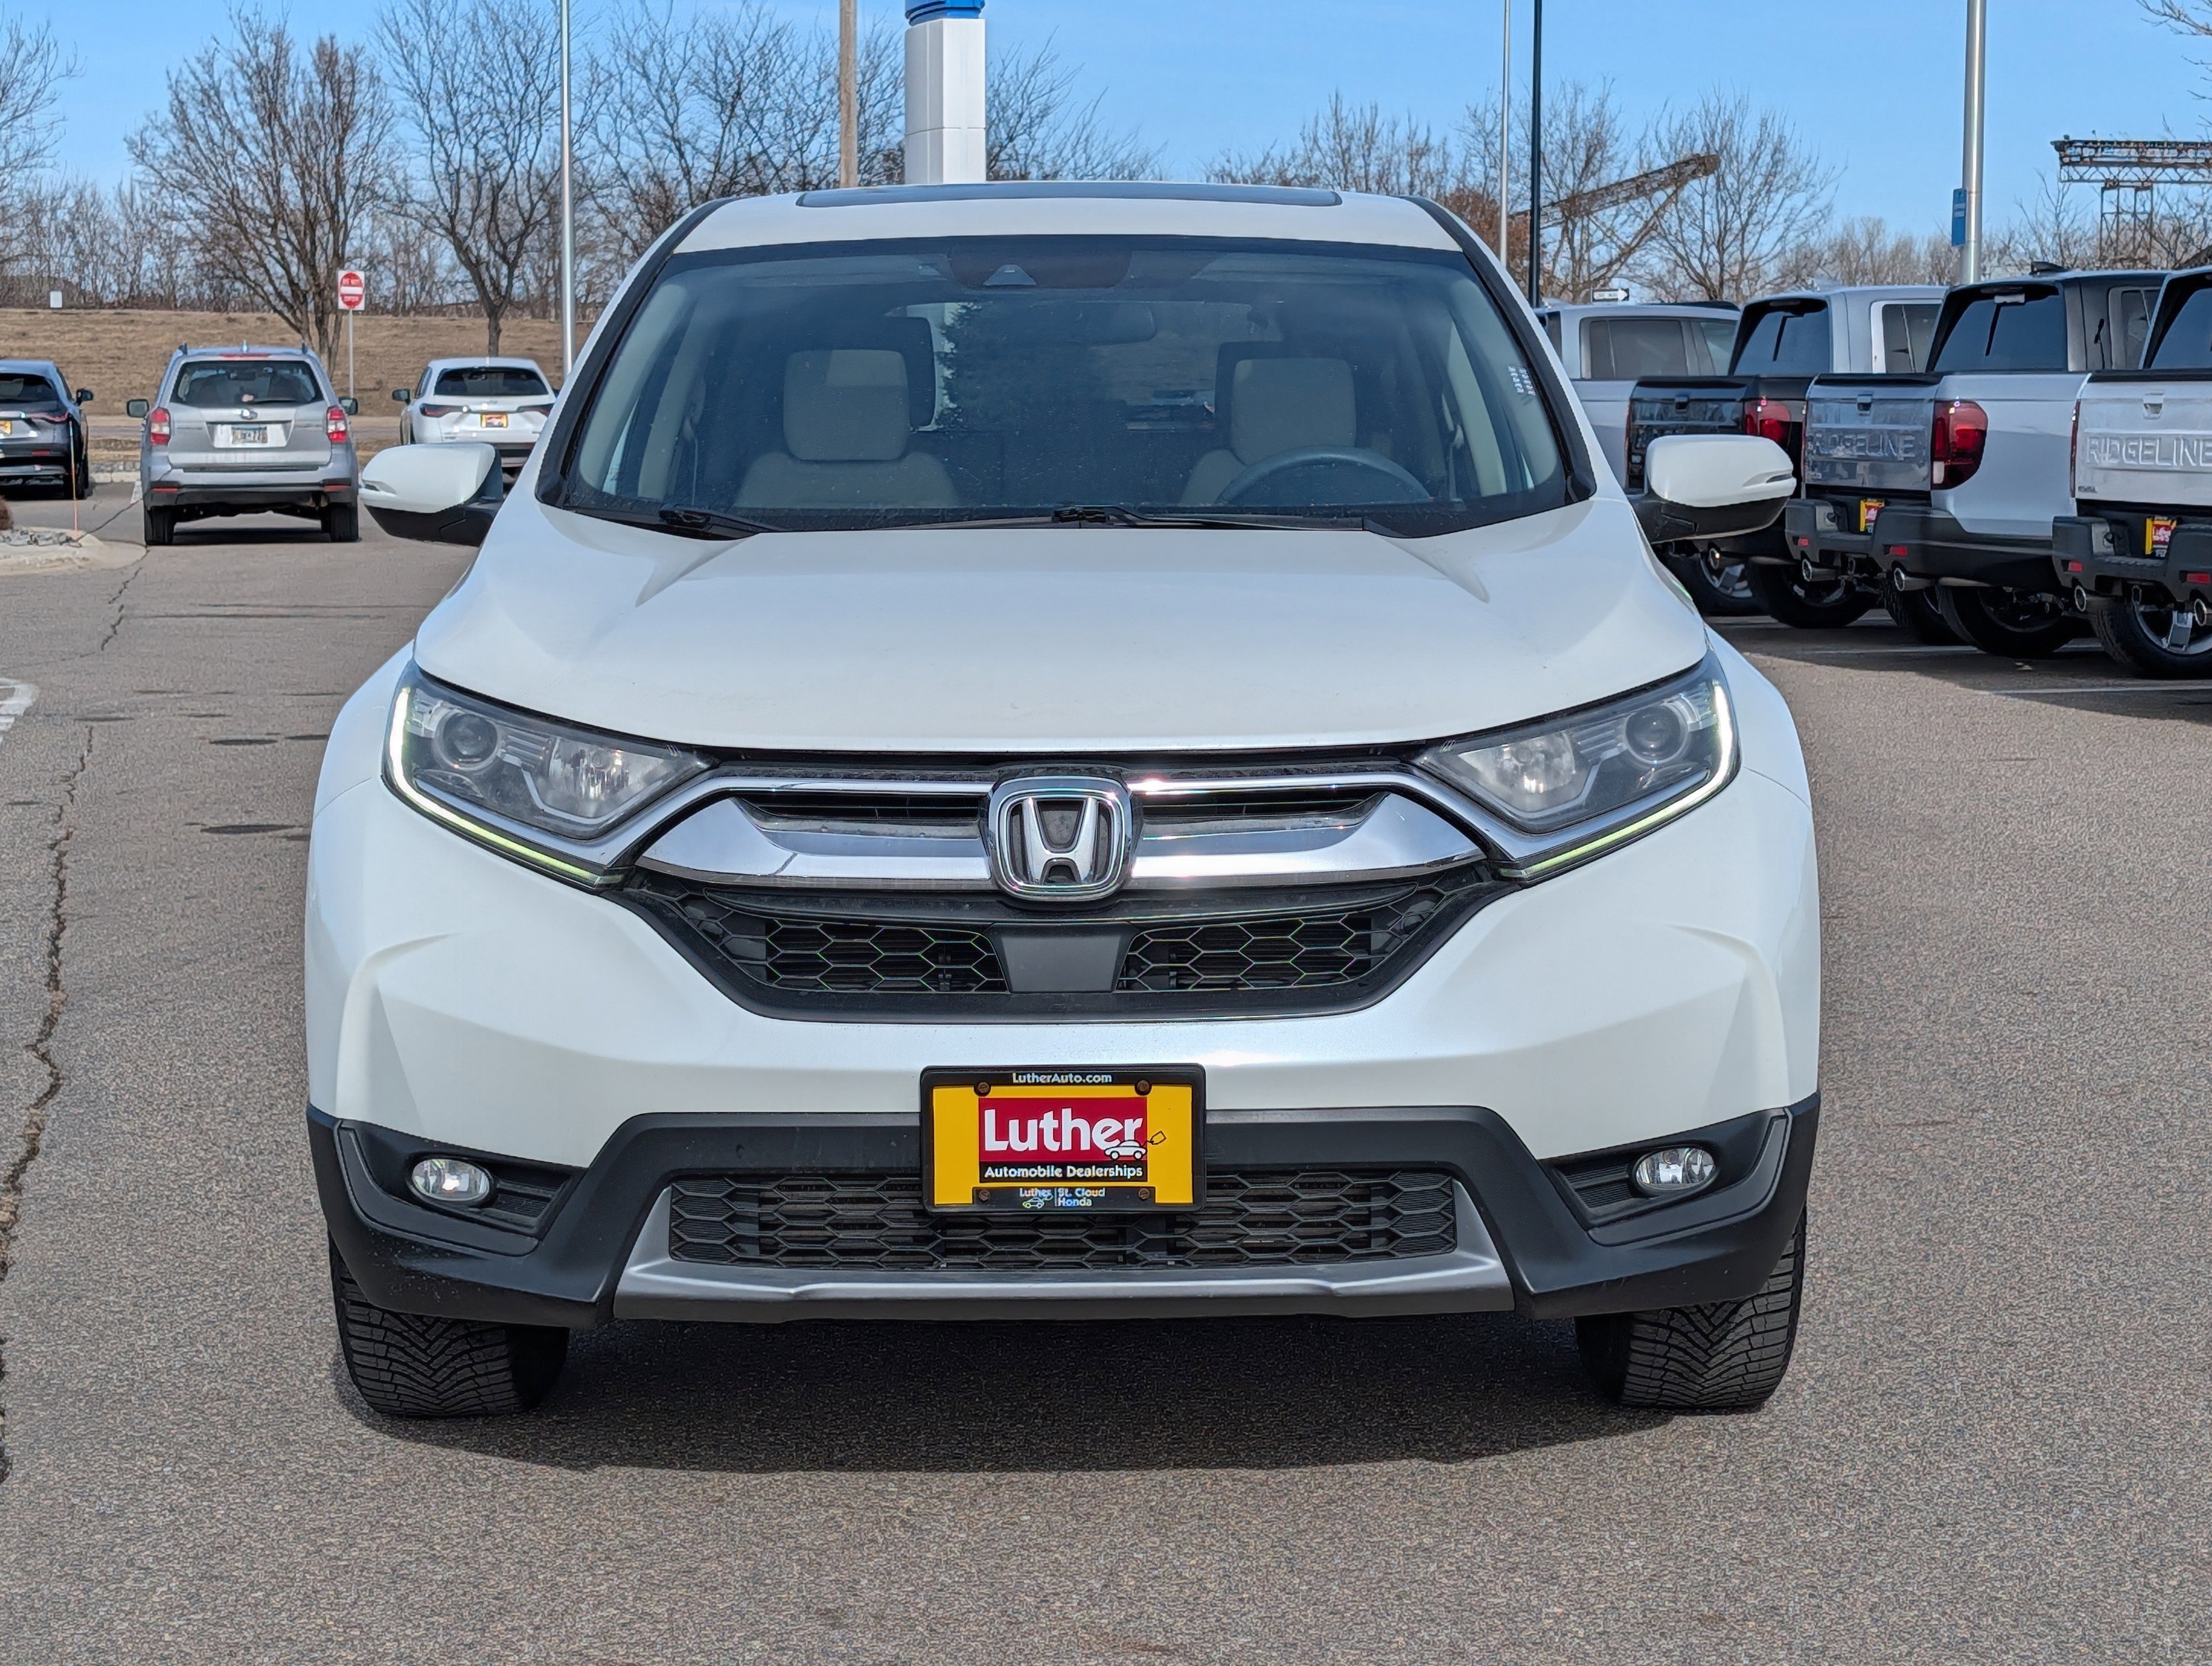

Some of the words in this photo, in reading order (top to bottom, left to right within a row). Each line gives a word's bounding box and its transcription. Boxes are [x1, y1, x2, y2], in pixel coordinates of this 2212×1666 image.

[2087, 437, 2212, 466] RIDGELINE
[1012, 1072, 1112, 1084] LutherAuto.com
[984, 1107, 1144, 1151] Luther
[984, 1165, 1063, 1178] Automobile
[1066, 1164, 1143, 1179] Dealerships
[1019, 1187, 1052, 1197] Luther
[1058, 1187, 1072, 1197] St.
[1075, 1187, 1105, 1197] Cloud
[1058, 1197, 1092, 1207] Honda
